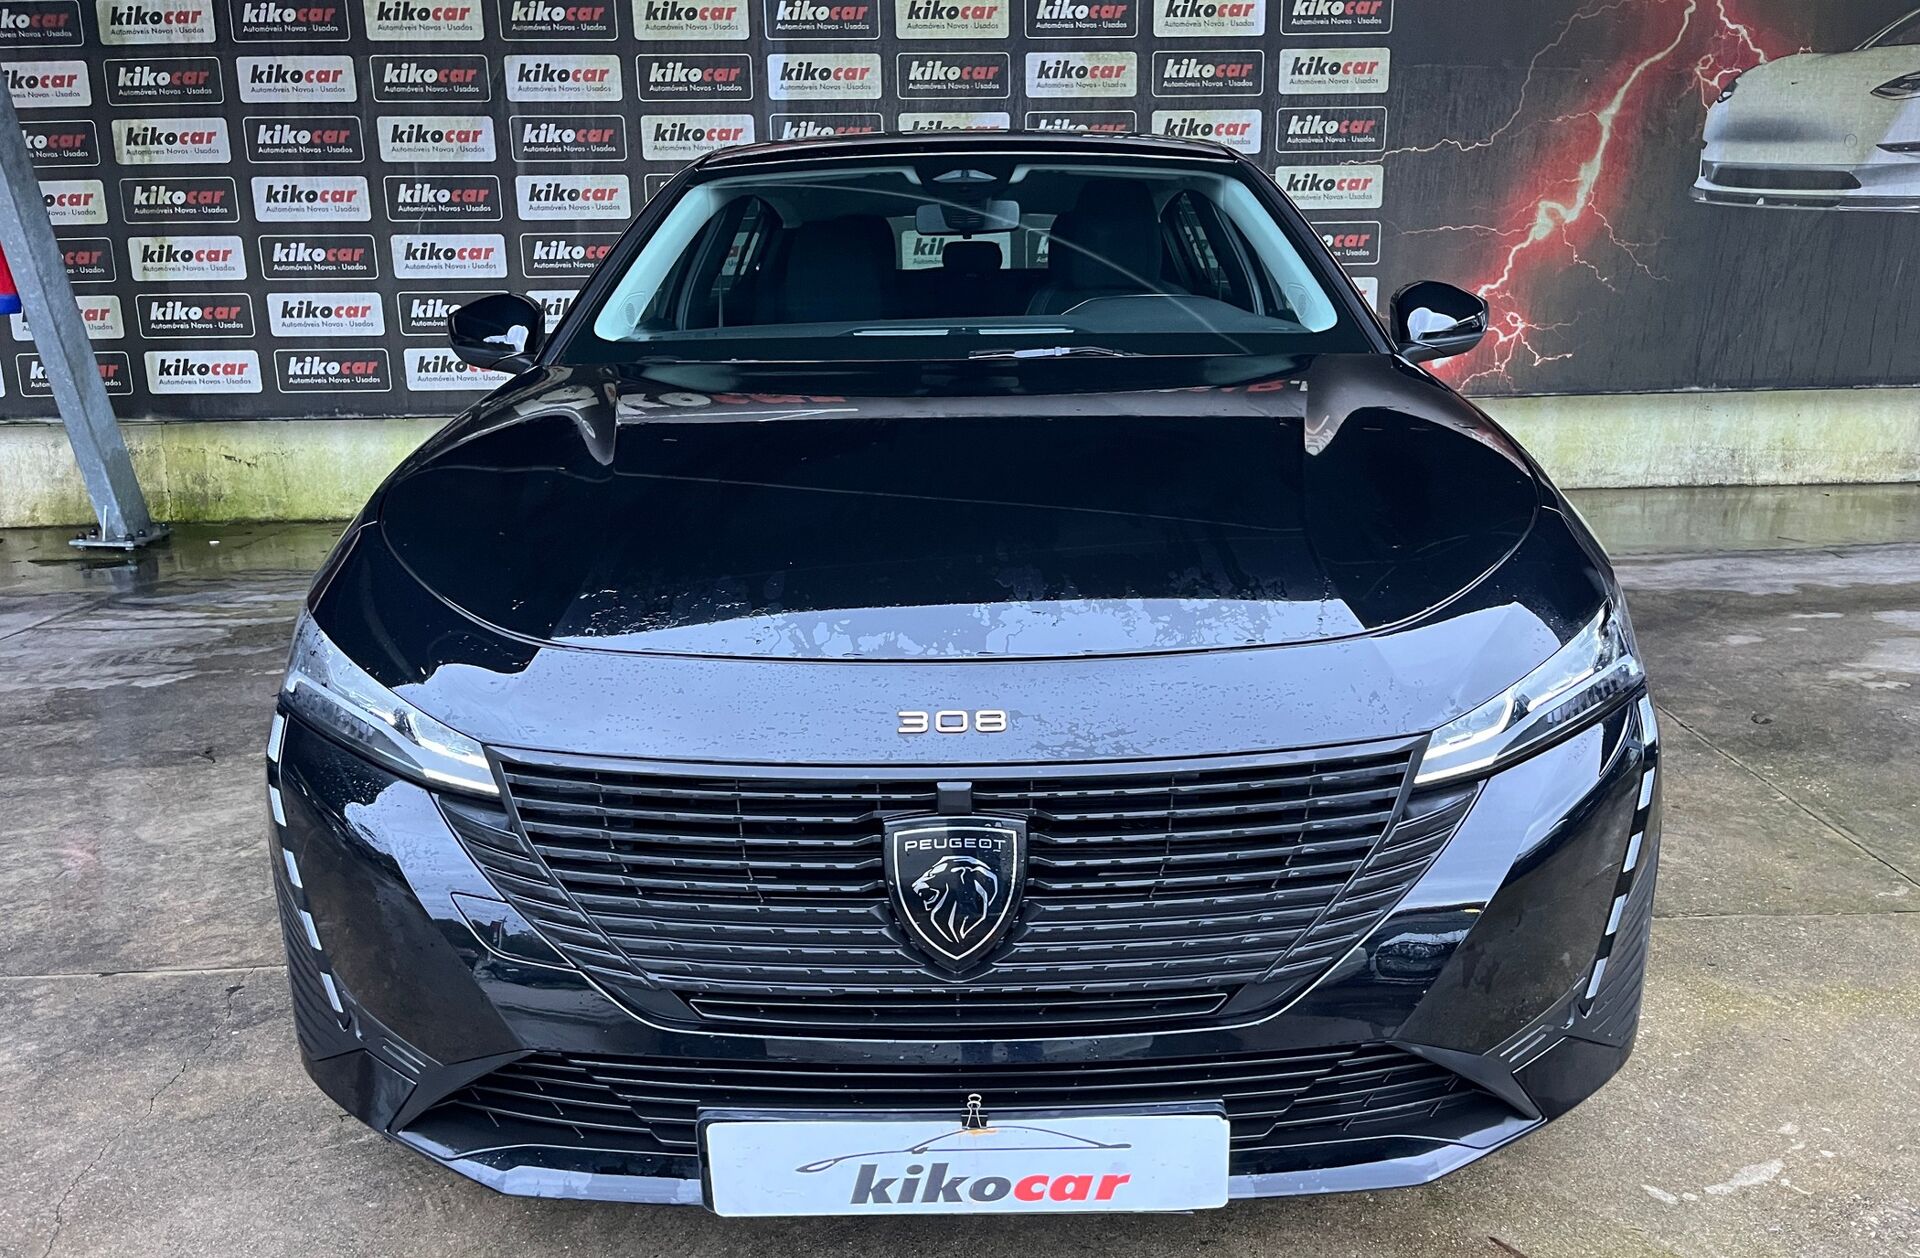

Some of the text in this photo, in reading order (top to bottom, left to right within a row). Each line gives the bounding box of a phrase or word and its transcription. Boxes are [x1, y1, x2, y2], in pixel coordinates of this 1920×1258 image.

[111, 6, 201, 26] kikocar
[243, 3, 334, 22] kikocar
[377, 2, 470, 21] kikocar
[512, 1, 603, 22] kikocar
[645, 1, 736, 20] kikocar
[777, 1, 867, 21] kikocar
[908, 0, 997, 19] kikocar
[1037, 0, 1126, 19] kikocar
[1166, 0, 1254, 17] kikocar
[1293, 0, 1382, 16] kikocar
[0, 9, 69, 28] kocar
[1103, 21, 1127, 29] Usados
[1358, 17, 1381, 25] Usados
[152, 27, 173, 36] Novos
[179, 27, 204, 36] Usados
[251, 64, 342, 83] kikocar
[384, 63, 476, 83] kikocar
[518, 63, 609, 82] kikocar
[650, 63, 740, 81] kikocar
[780, 62, 870, 80] kikocar
[909, 61, 998, 80] kikocar
[1038, 60, 1125, 78] kikocar
[1164, 59, 1253, 78] kikocar
[1291, 57, 1378, 75] kikocar
[4, 70, 77, 89] kocar
[118, 67, 208, 87] kikocar
[975, 82, 999, 90] Usados
[454, 85, 479, 93] Usados
[717, 84, 742, 92] Usados
[391, 124, 482, 143] kikocar
[523, 124, 613, 143] kikocar
[654, 123, 743, 141] kikocar
[1163, 118, 1251, 136] kikocar
[1287, 115, 1374, 134] kikocar
[22, 130, 86, 149] kocar
[126, 127, 216, 146] kikocar
[258, 125, 349, 144] kikocar
[1286, 173, 1372, 191] kikocar
[43, 193, 94, 207] ocar
[134, 186, 224, 205] kikocar
[266, 185, 356, 203] kikocar
[398, 184, 488, 203] kikocar
[529, 183, 618, 201] kikocar
[1325, 233, 1370, 248] ocar
[142, 245, 232, 262] kikocar
[273, 243, 364, 262] kikocar
[405, 243, 494, 260] kikocar
[533, 241, 611, 259] kikoca
[150, 302, 240, 320] kikocar
[281, 301, 370, 318] kikocar
[349, 320, 373, 328] Usados
[159, 359, 247, 376] kikocar
[288, 357, 377, 375] kikocar
[356, 376, 380, 384] Usados
[897, 710, 1007, 733] 308
[904, 838, 1006, 852] PEUGEOT
[850, 1162, 1131, 1204] kikocar
